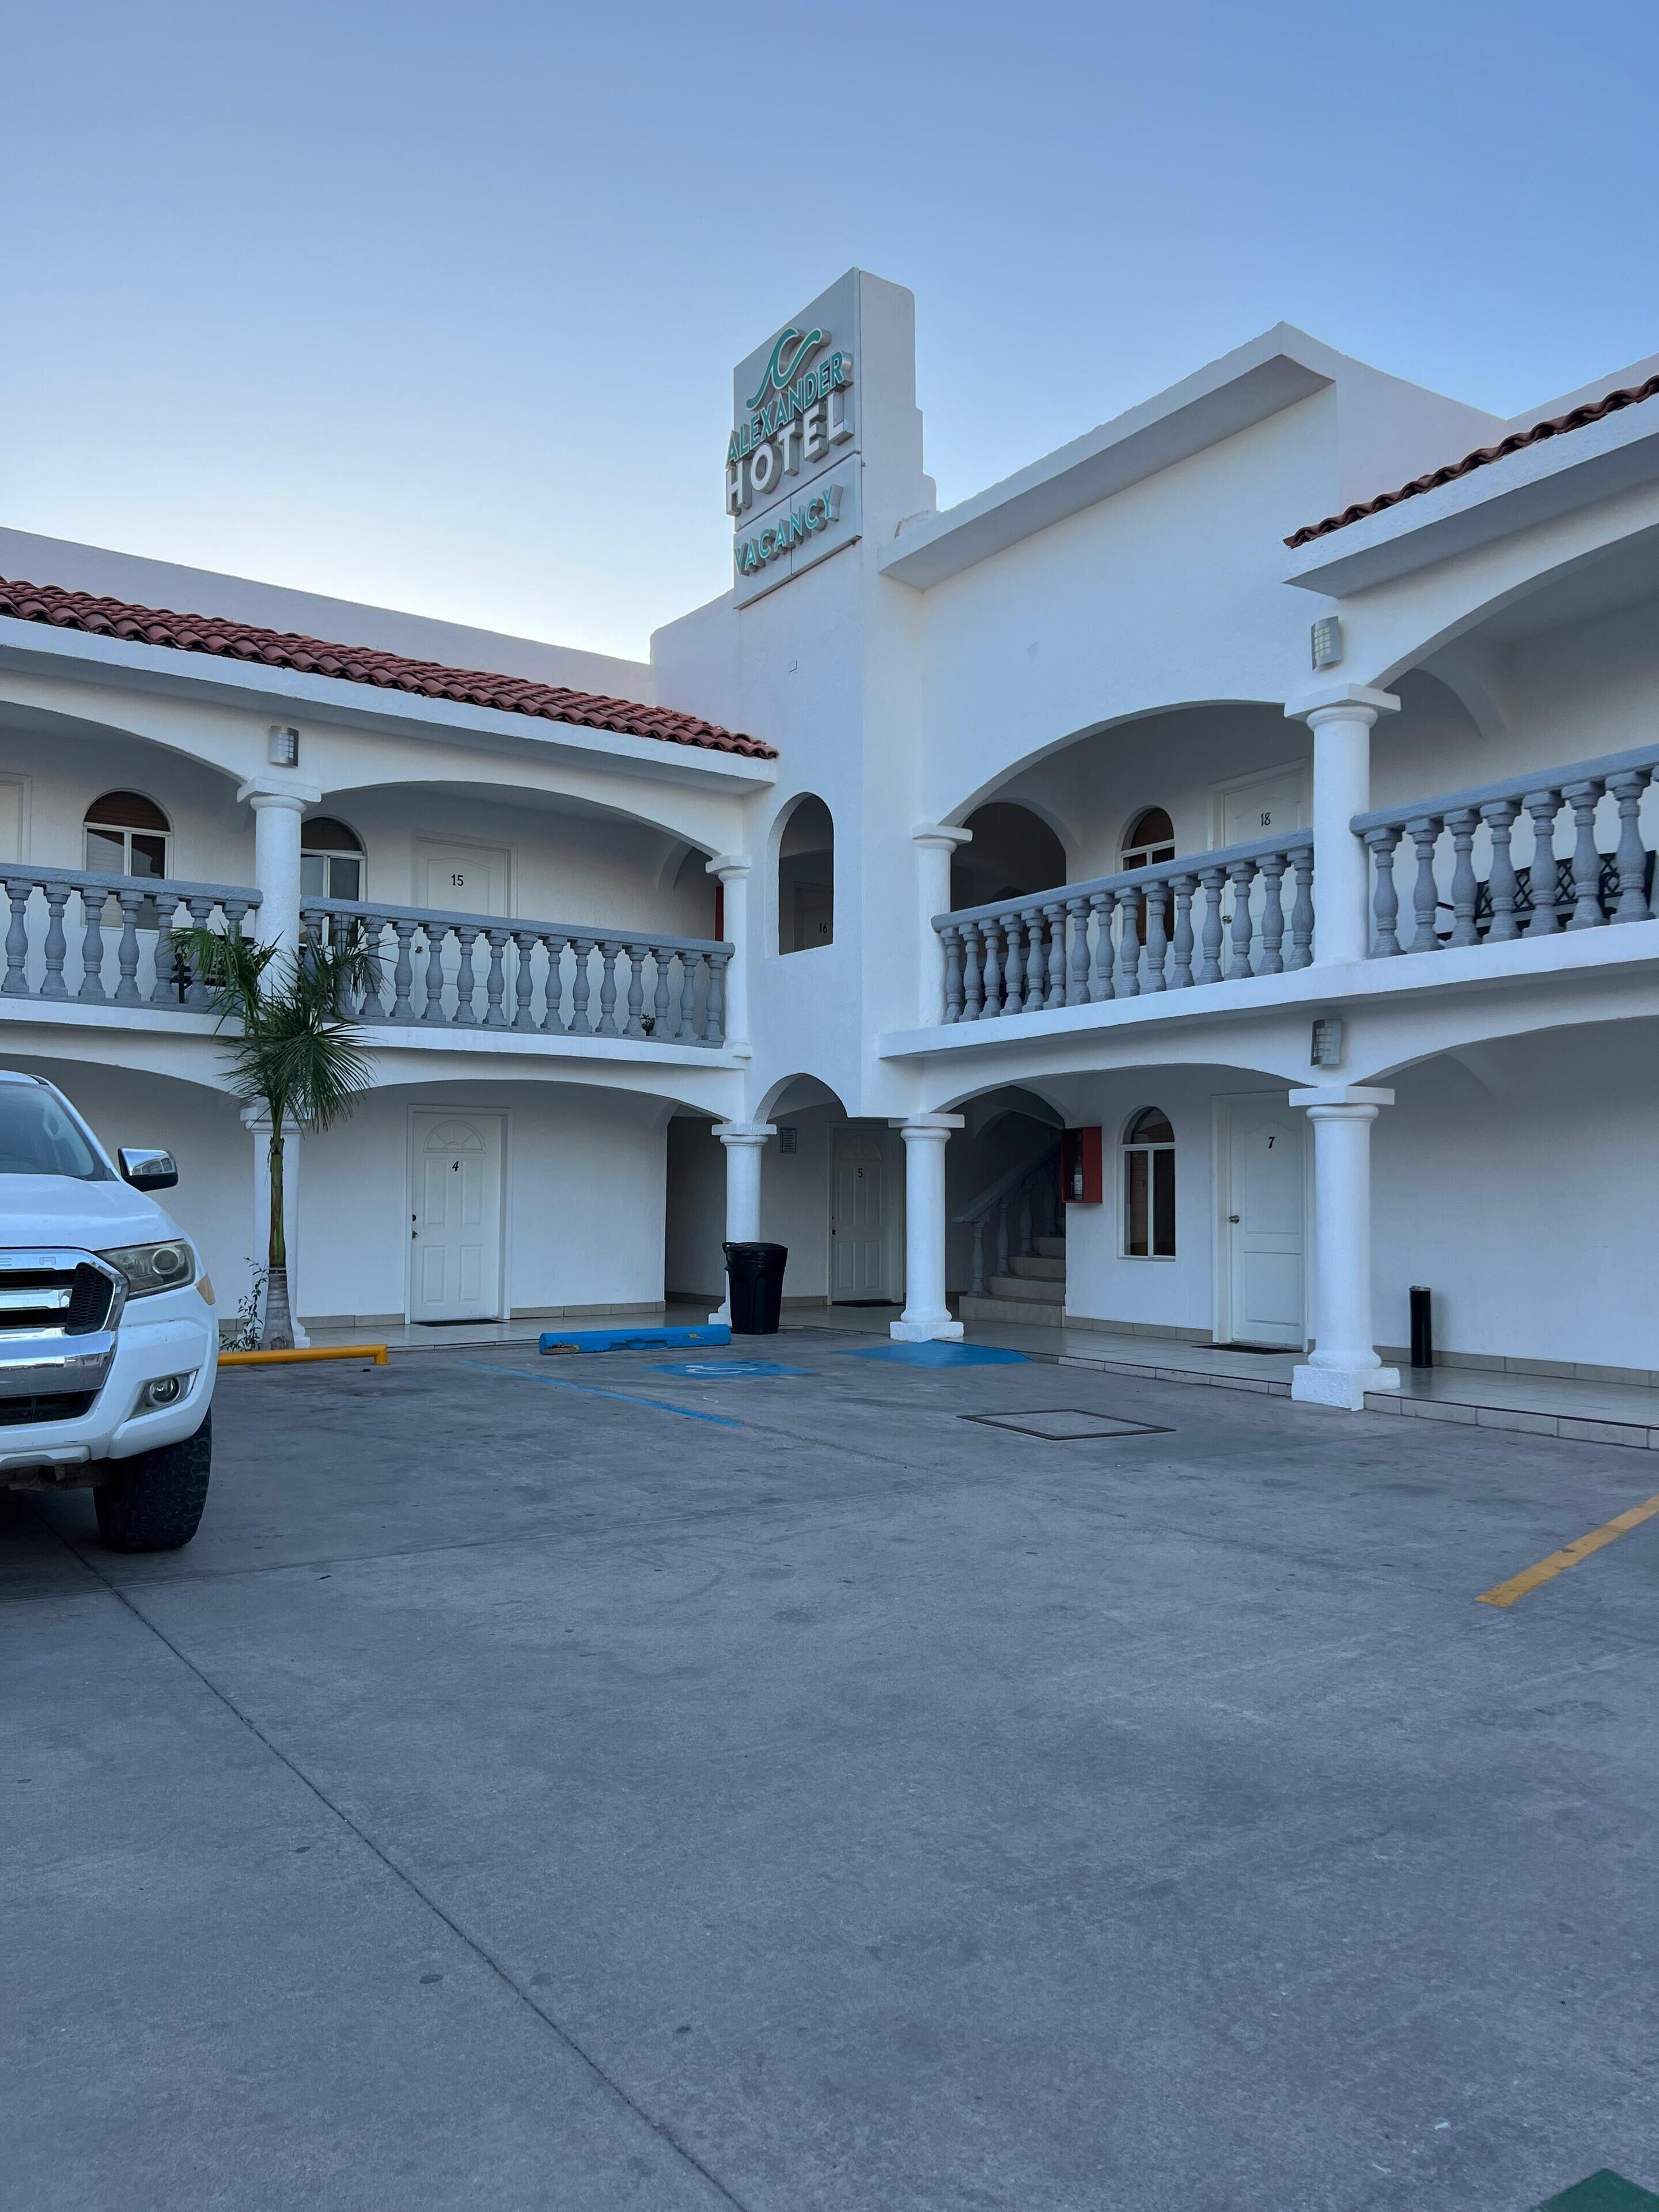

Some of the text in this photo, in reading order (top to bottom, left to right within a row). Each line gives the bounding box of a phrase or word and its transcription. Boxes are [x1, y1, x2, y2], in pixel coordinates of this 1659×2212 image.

[725, 350, 846, 468] ALEXANDER
[726, 392, 848, 516] HOTEL
[734, 484, 837, 575] VACANCY
[1261, 812, 1271, 827] 18
[452, 874, 464, 886] 15
[819, 922, 828, 933] 16
[1268, 1136, 1275, 1149] 7
[452, 1161, 459, 1172] 4
[858, 1168, 863, 1178] 5
